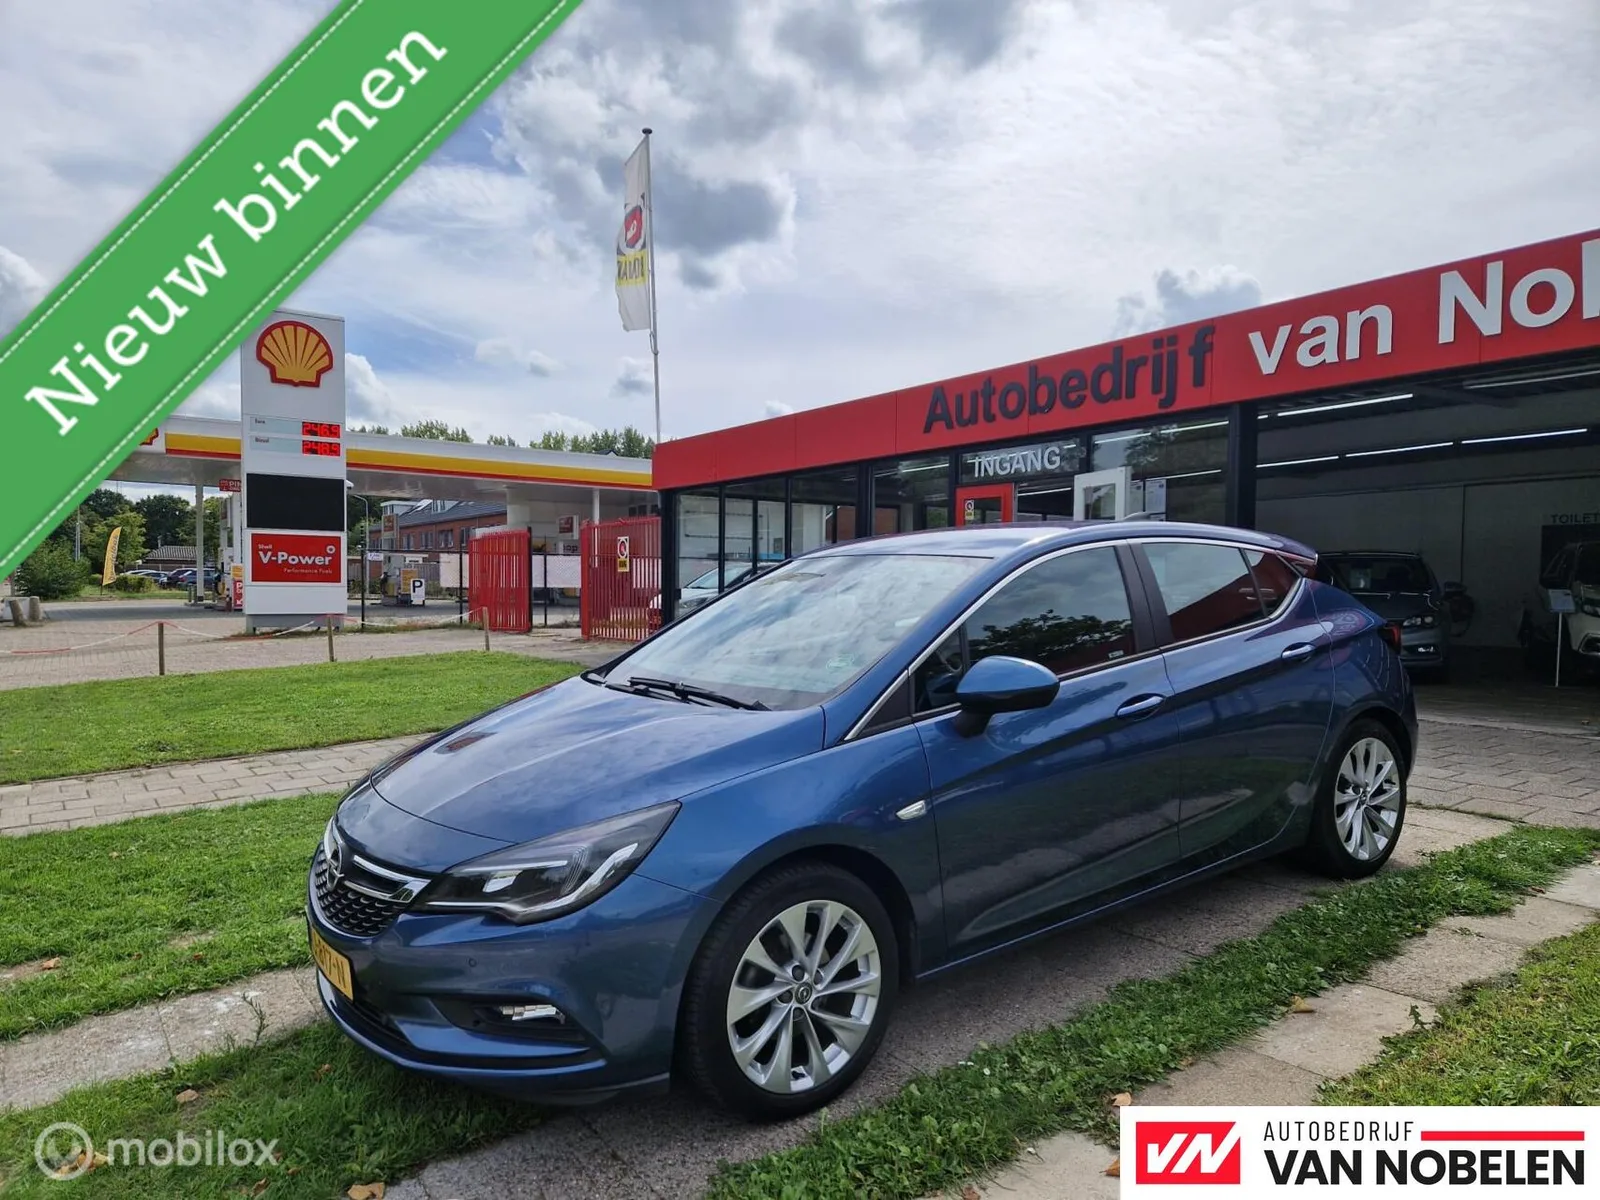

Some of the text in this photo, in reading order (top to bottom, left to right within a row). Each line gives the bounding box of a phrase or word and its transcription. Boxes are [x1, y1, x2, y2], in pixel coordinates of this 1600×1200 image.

[922, 326, 1216, 434] Autobedrijf
[1247, 303, 1394, 376] van
[974, 446, 1061, 478] INGANG
[258, 551, 333, 566] V-Power
[412, 579, 423, 594] P
